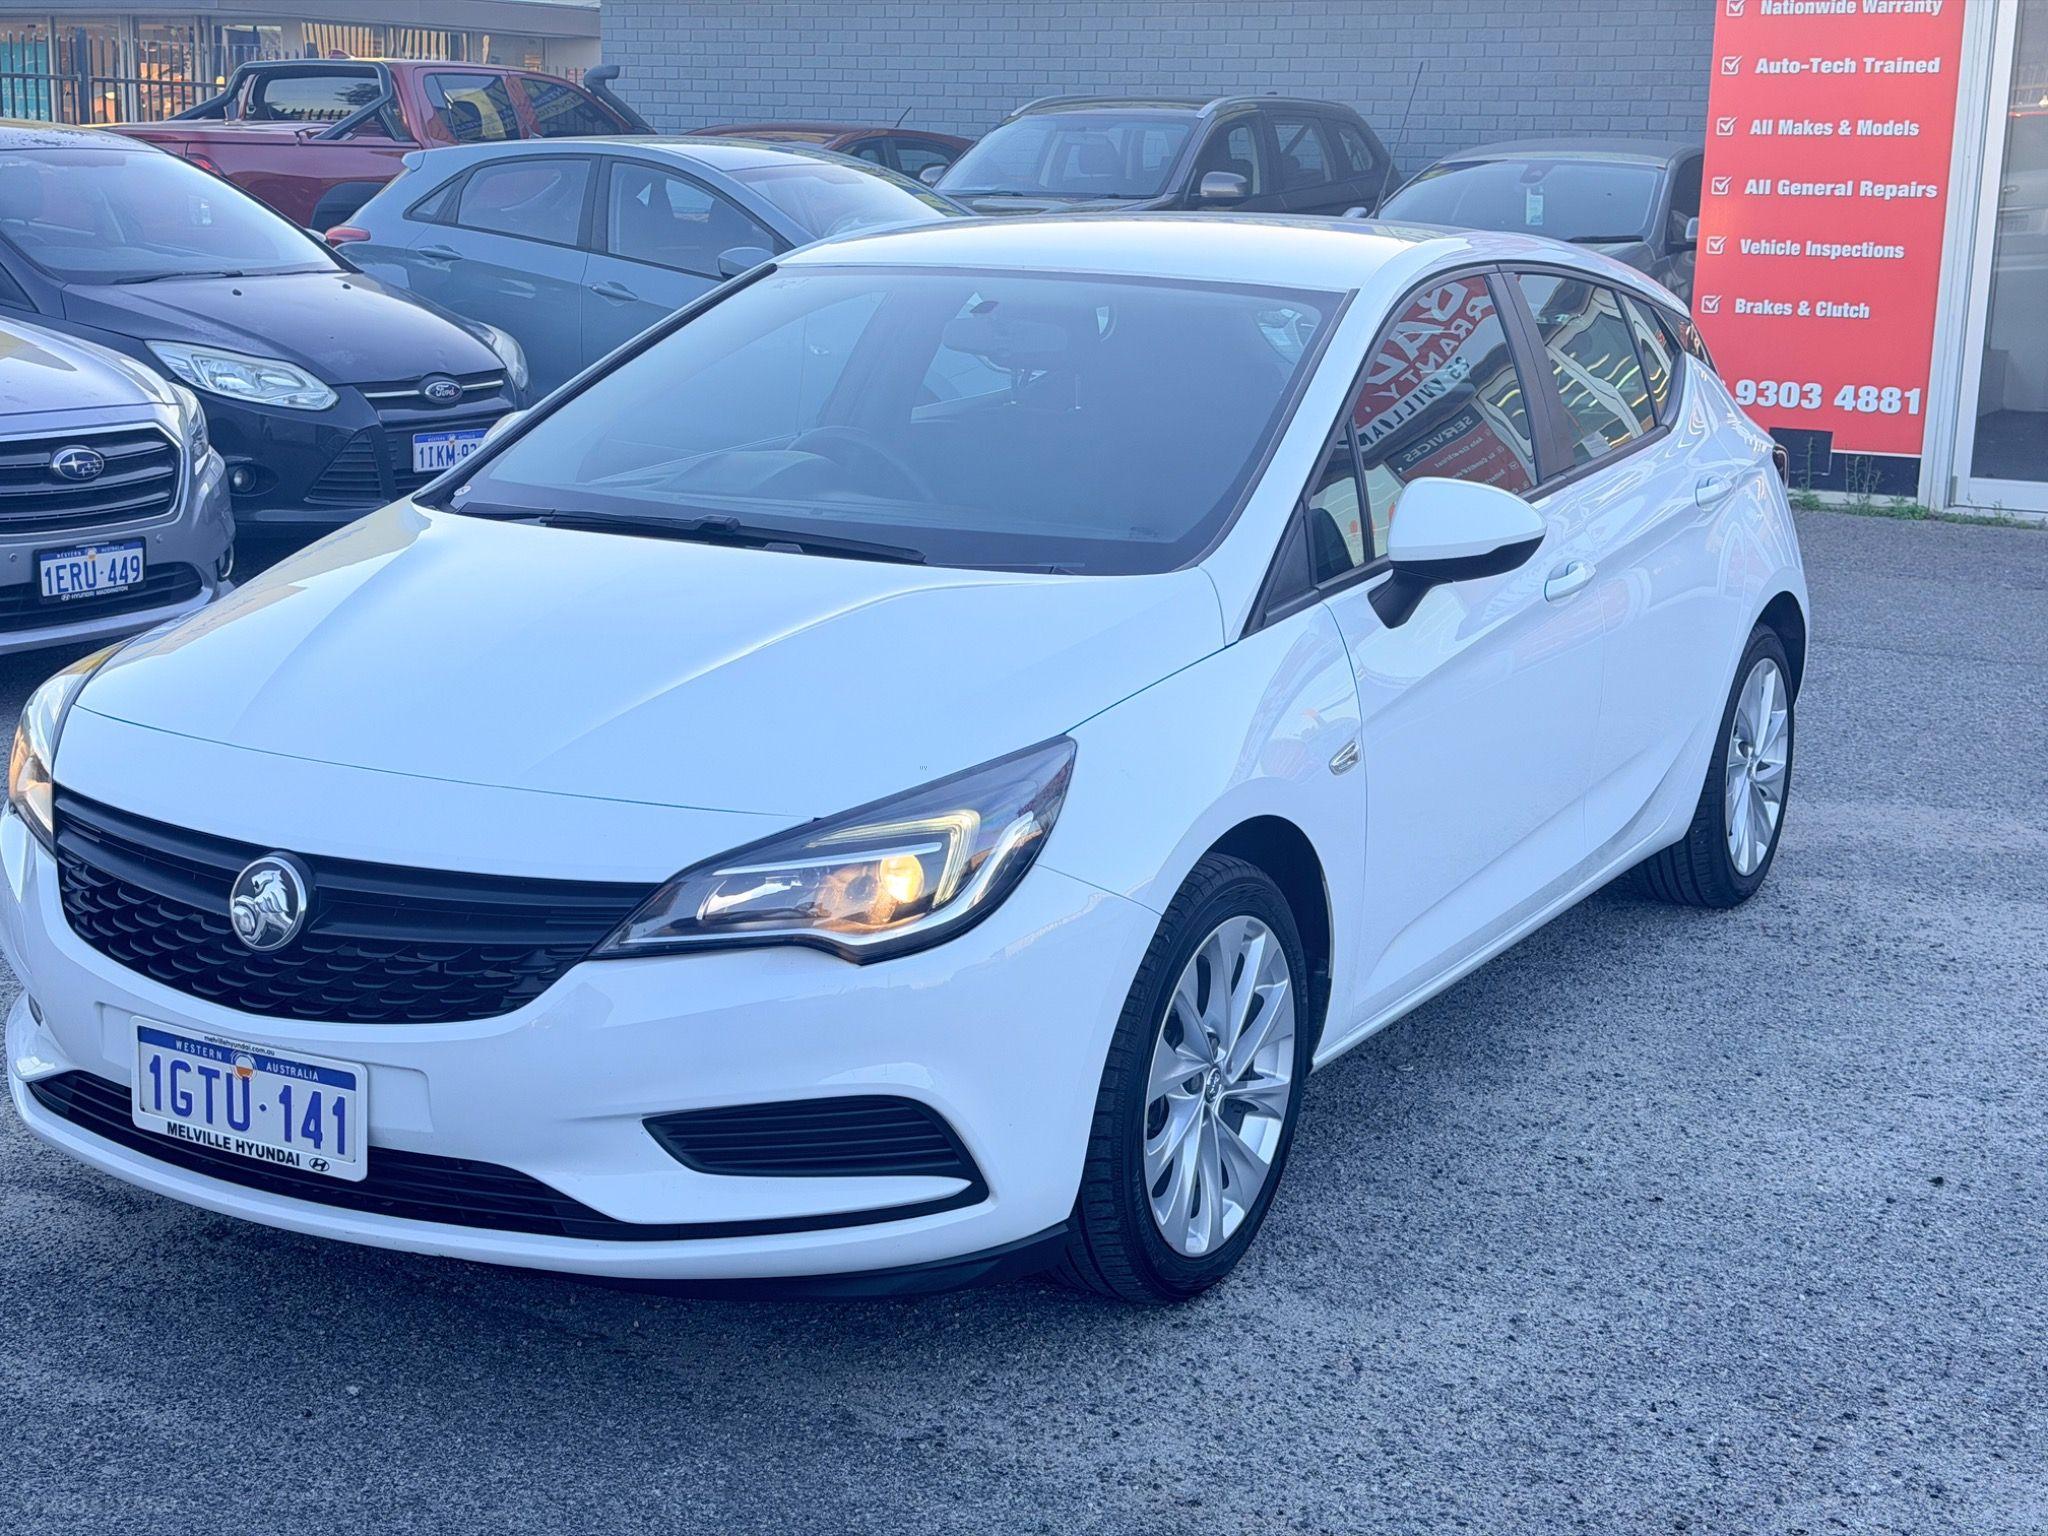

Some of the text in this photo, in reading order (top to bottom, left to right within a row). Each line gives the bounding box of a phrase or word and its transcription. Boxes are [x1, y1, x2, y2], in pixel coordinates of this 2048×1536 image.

[1760, 0, 1943, 17] Nationwide Warranty
[1755, 57, 1941, 75] Auto-Tech Trained
[1749, 119, 1920, 137] All Makes & Models
[1744, 178, 1938, 200] All General Repairs
[1739, 238, 1905, 260] Vehicle Inspections
[1734, 298, 1870, 319] Brakes & Clutch
[435, 384, 455, 397] Ford
[1735, 379, 1921, 415] 9303 4881
[175, 1038, 320, 1082] WESTERN AUSTRALIA
[166, 1121, 301, 1167] MELVILLE HYUNDAI
